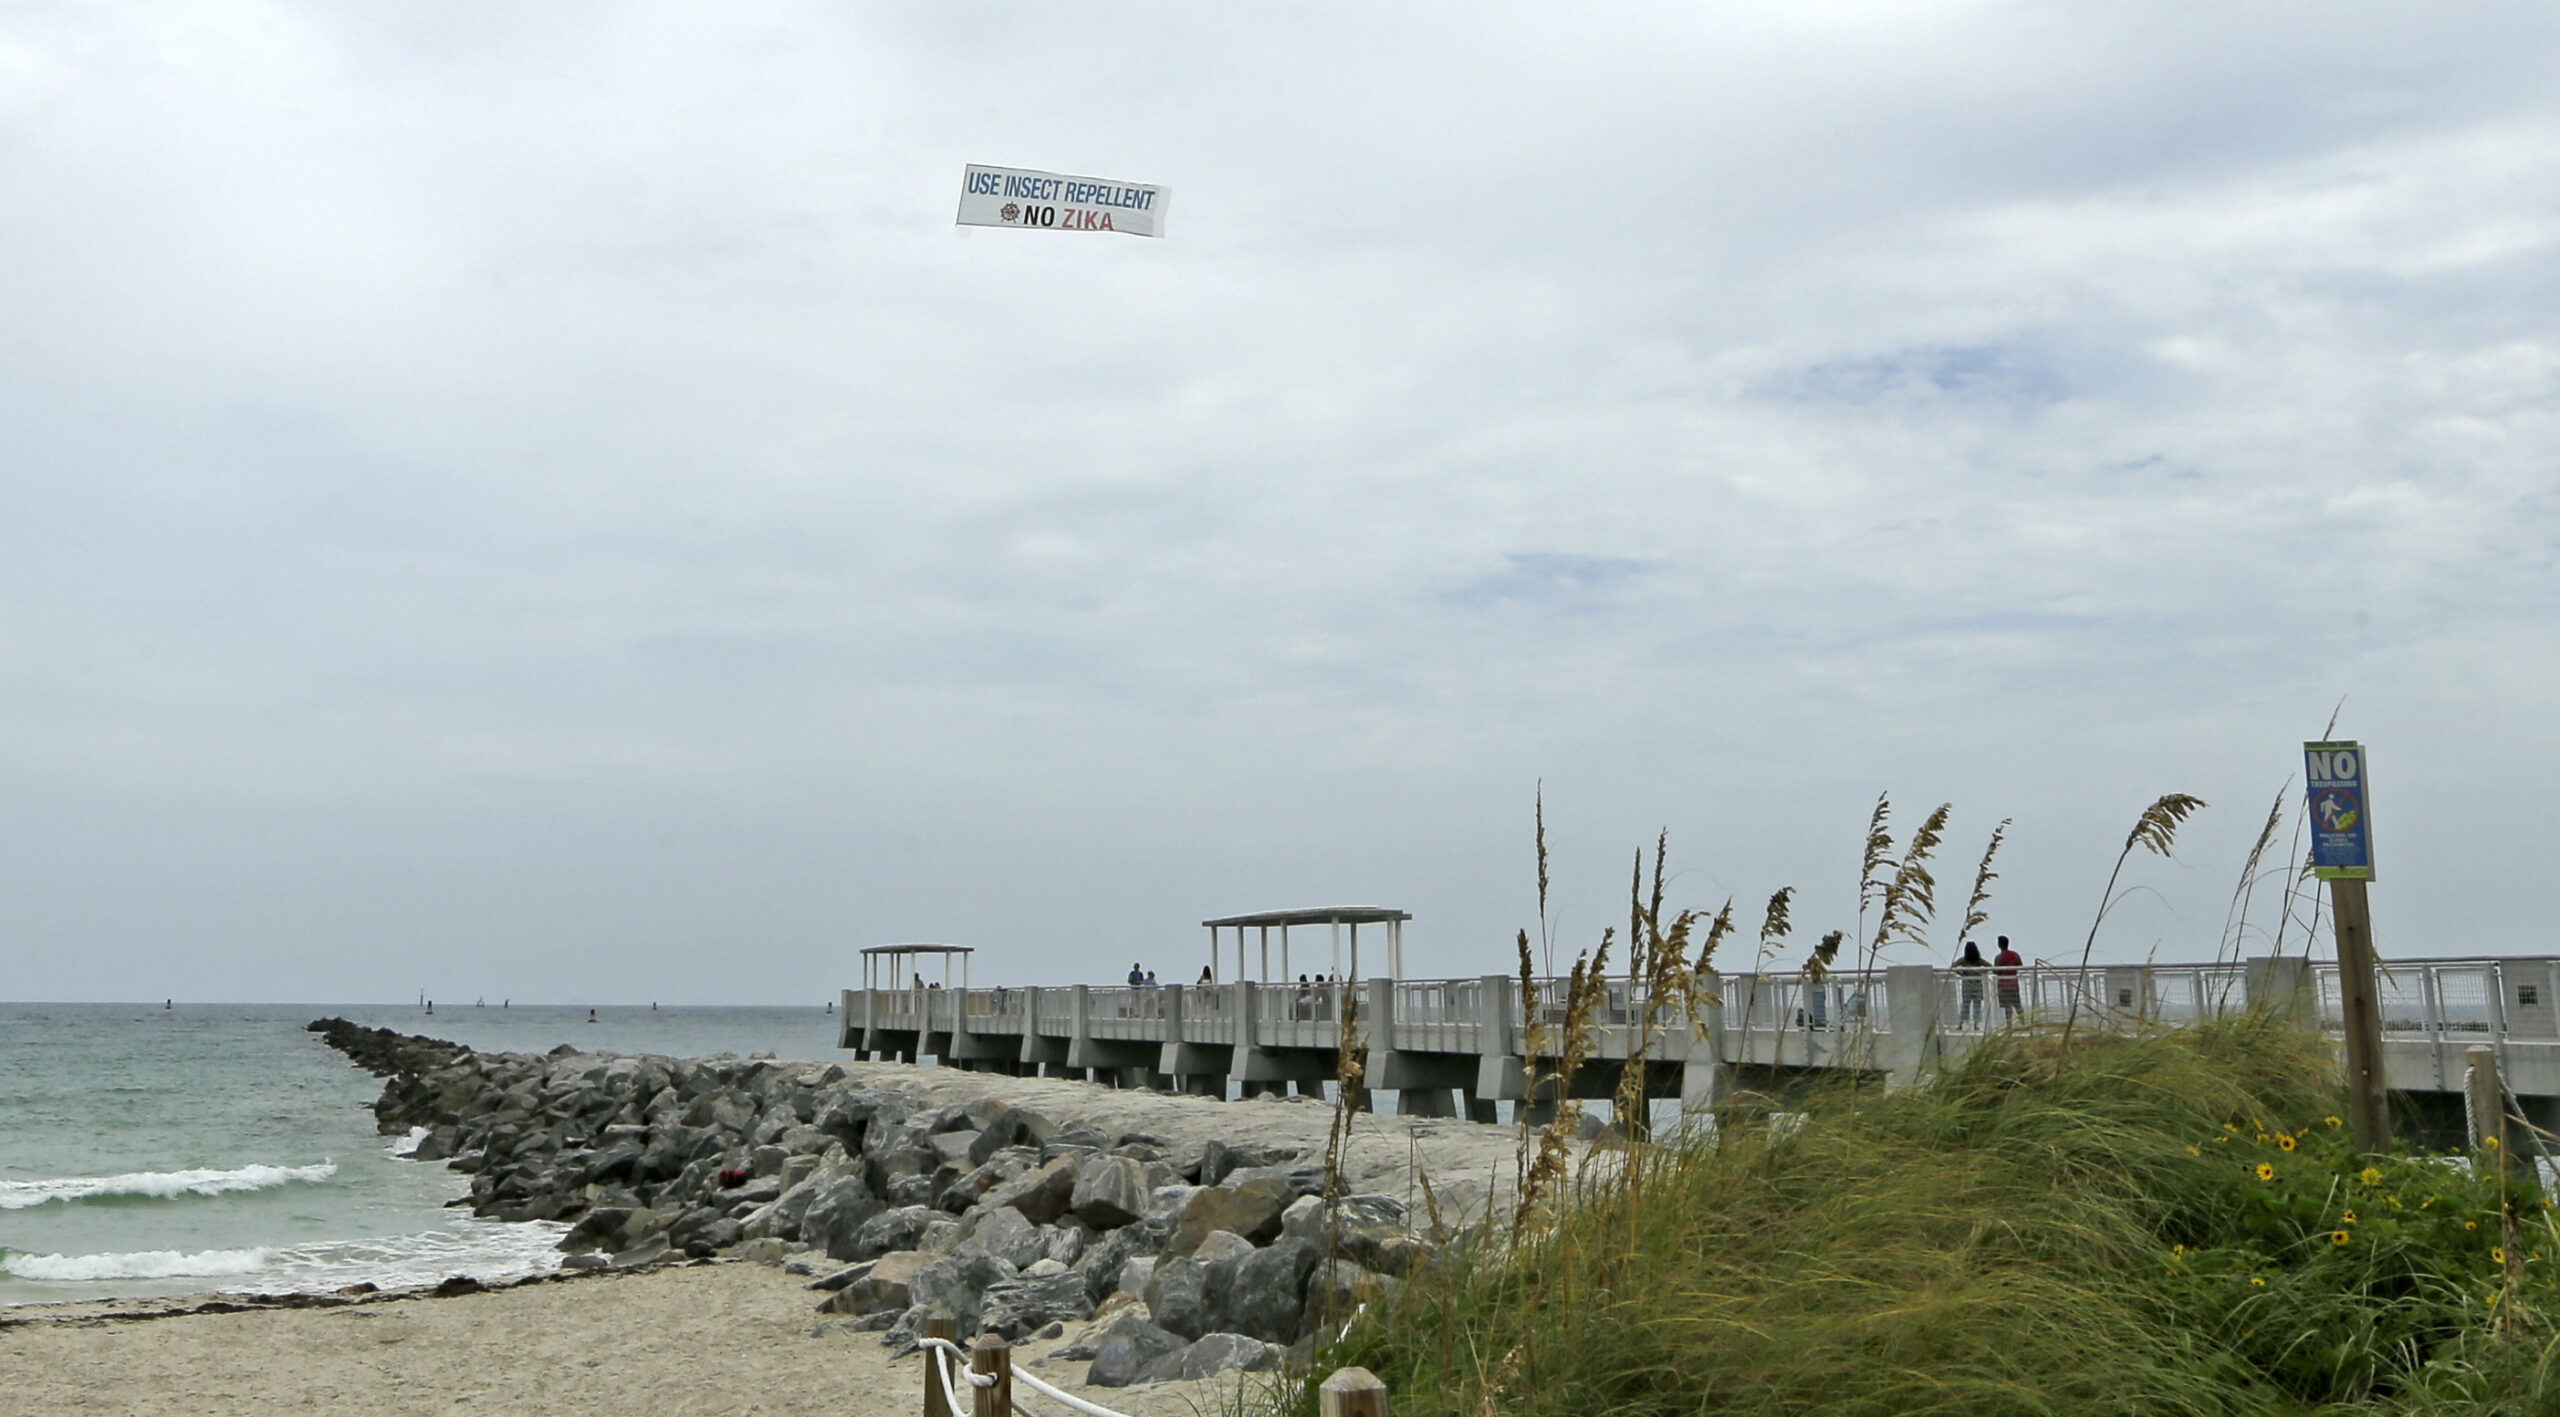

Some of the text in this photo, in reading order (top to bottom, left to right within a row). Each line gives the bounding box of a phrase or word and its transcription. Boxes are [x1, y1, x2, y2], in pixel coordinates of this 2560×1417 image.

[968, 172, 1155, 210] USE INSECT REPELLENT
[1023, 205, 1114, 231] NO ZIKA
[2308, 751, 2357, 779] NO
